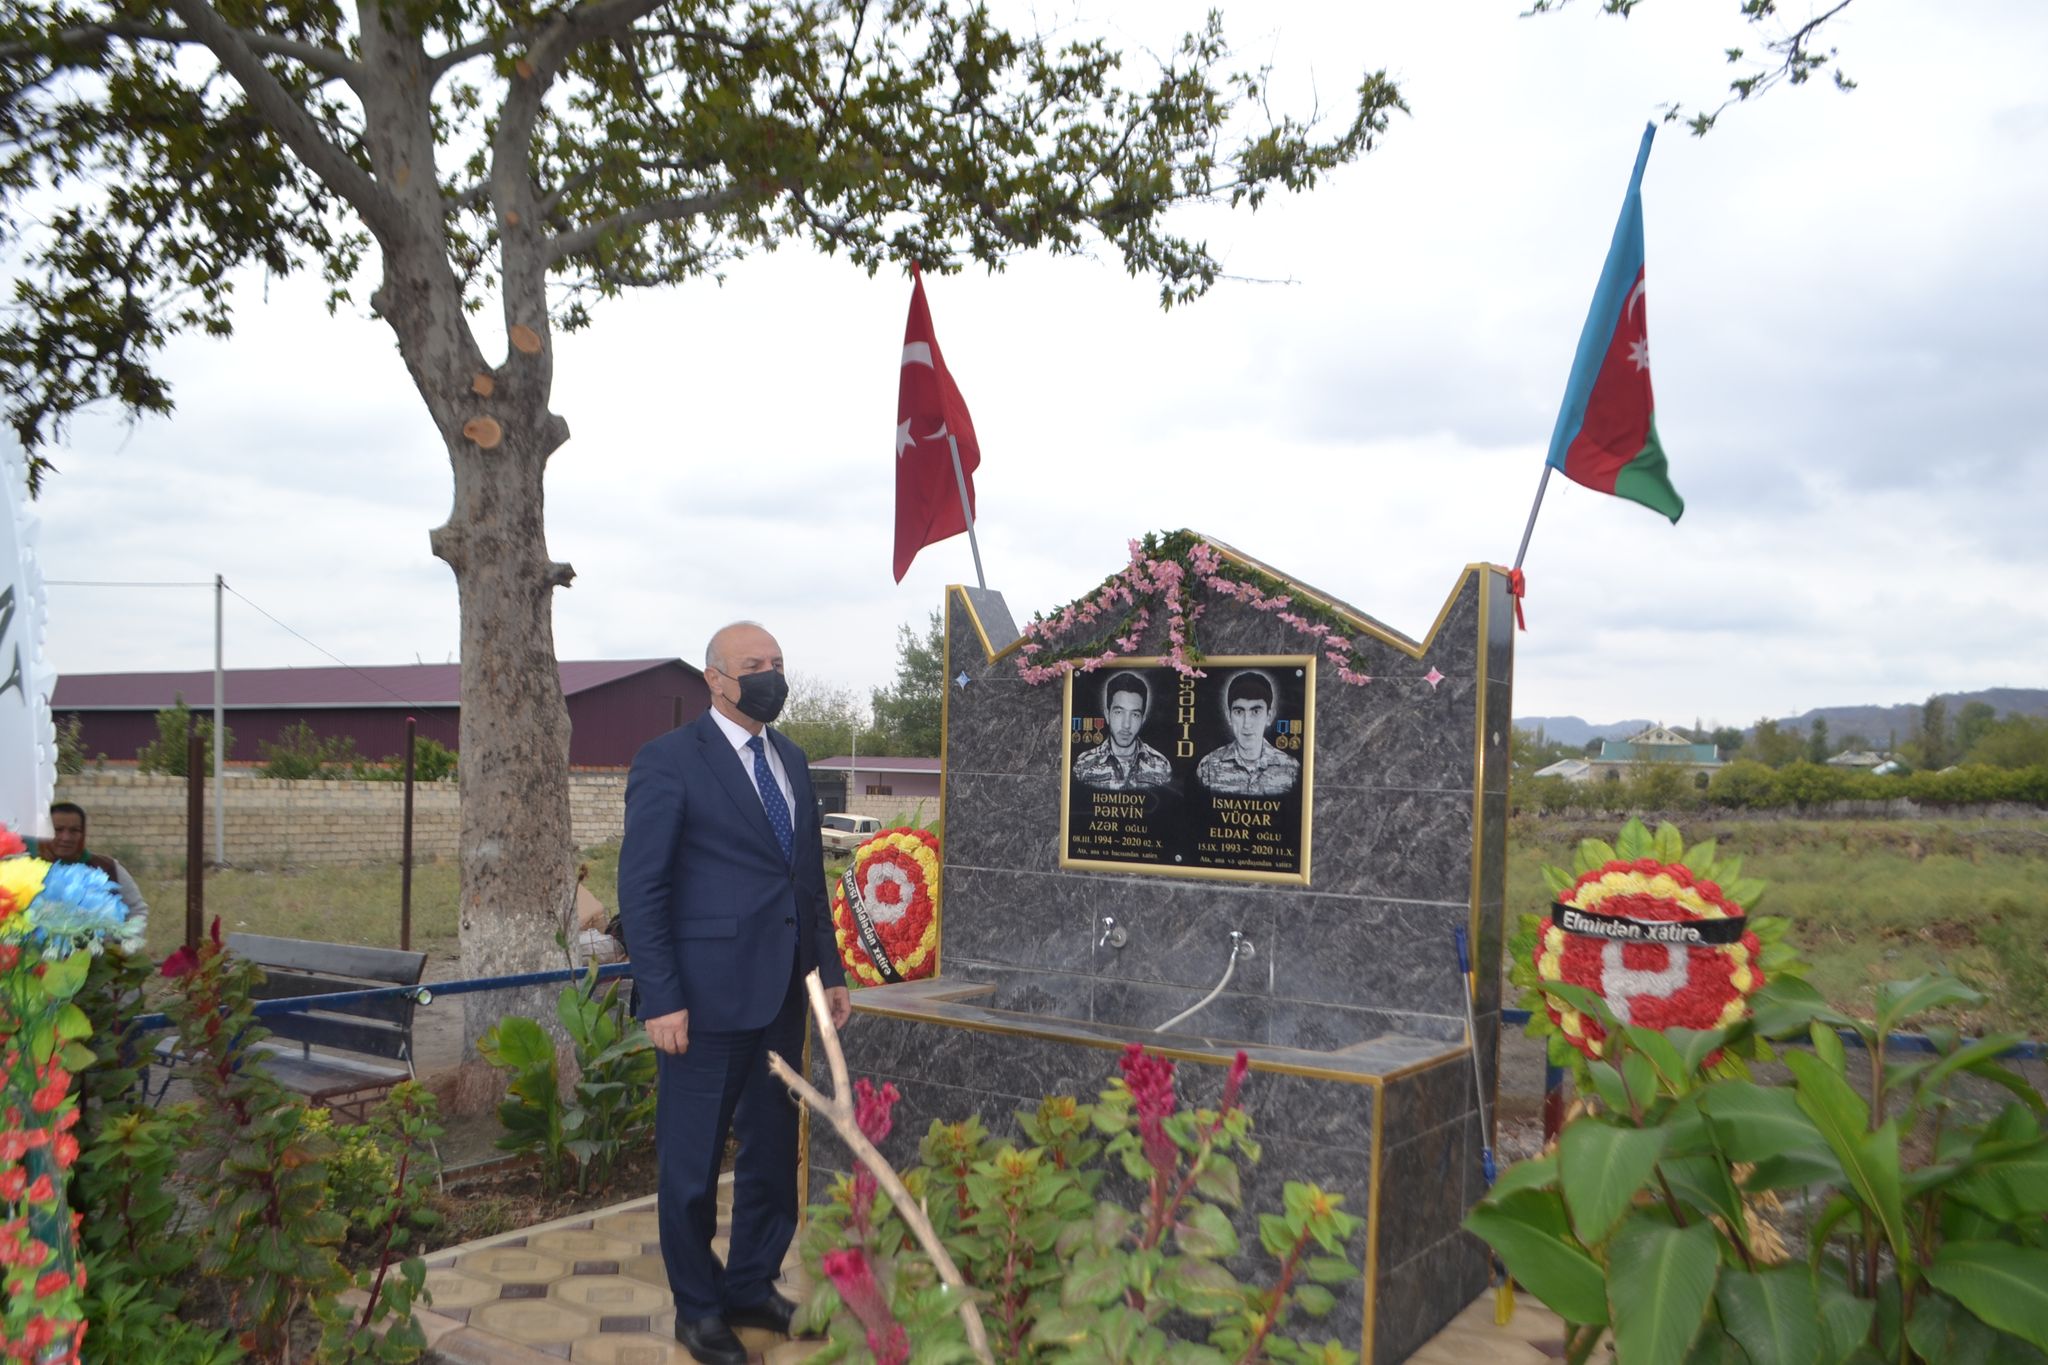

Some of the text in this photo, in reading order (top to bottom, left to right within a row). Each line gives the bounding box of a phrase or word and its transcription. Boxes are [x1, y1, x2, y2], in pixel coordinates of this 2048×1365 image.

[1093, 793, 1146, 804] HƏMİDOV
[1213, 797, 1281, 811] İSMAYILOV
[1094, 806, 1143, 819] PƏRVİN
[1221, 811, 1271, 827] VÜQAR
[1089, 821, 1147, 833] AZƏR OĞLU
[1094, 836, 1112, 845] 1994
[1122, 837, 1141, 846] 2020
[1210, 828, 1281, 841] ELDAR OĞLU
[1221, 843, 1241, 853] 1993
[1252, 845, 1273, 855] 2020
[1644, 922, 1700, 942] xatirə
[872, 947, 892, 976] xatirə
